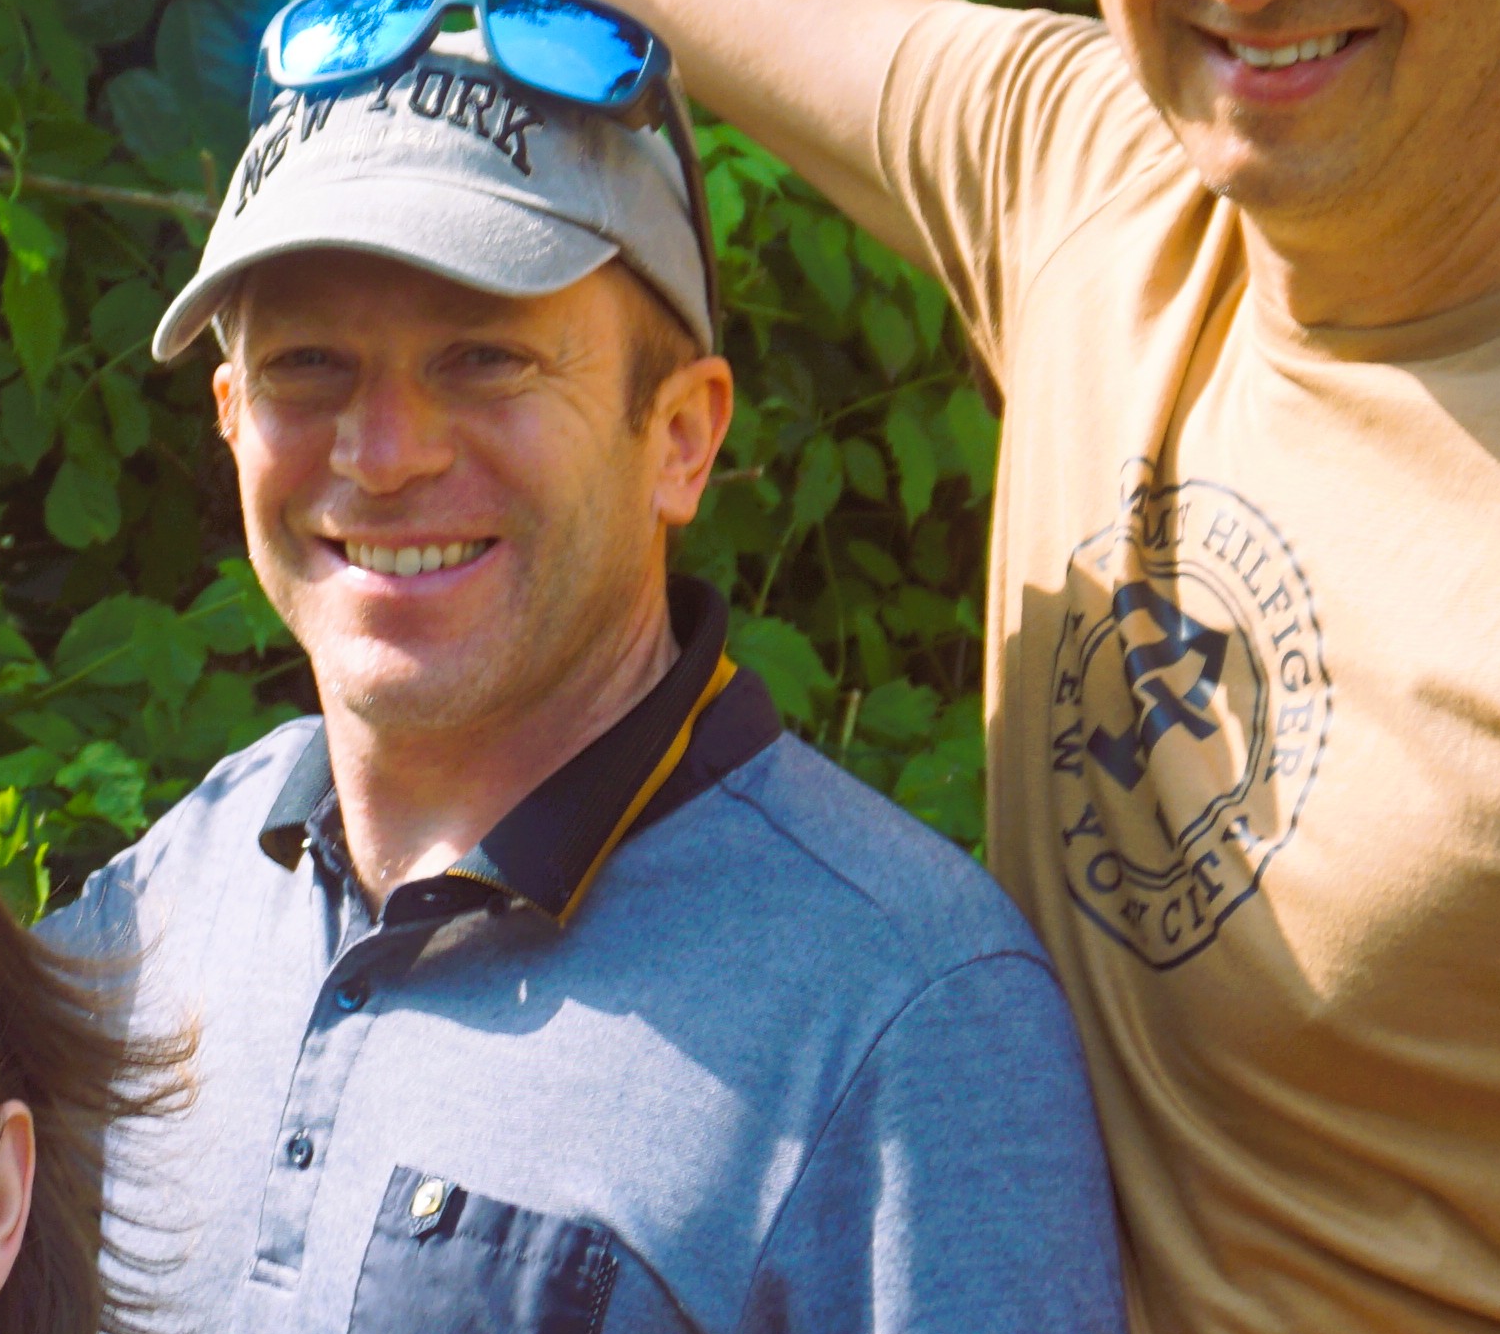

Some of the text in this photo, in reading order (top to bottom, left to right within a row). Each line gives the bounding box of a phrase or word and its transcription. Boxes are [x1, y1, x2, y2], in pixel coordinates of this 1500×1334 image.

[368, 63, 545, 177] YORK
[1201, 508, 1314, 784] HILFIGER
[1162, 815, 1264, 944] CITY
